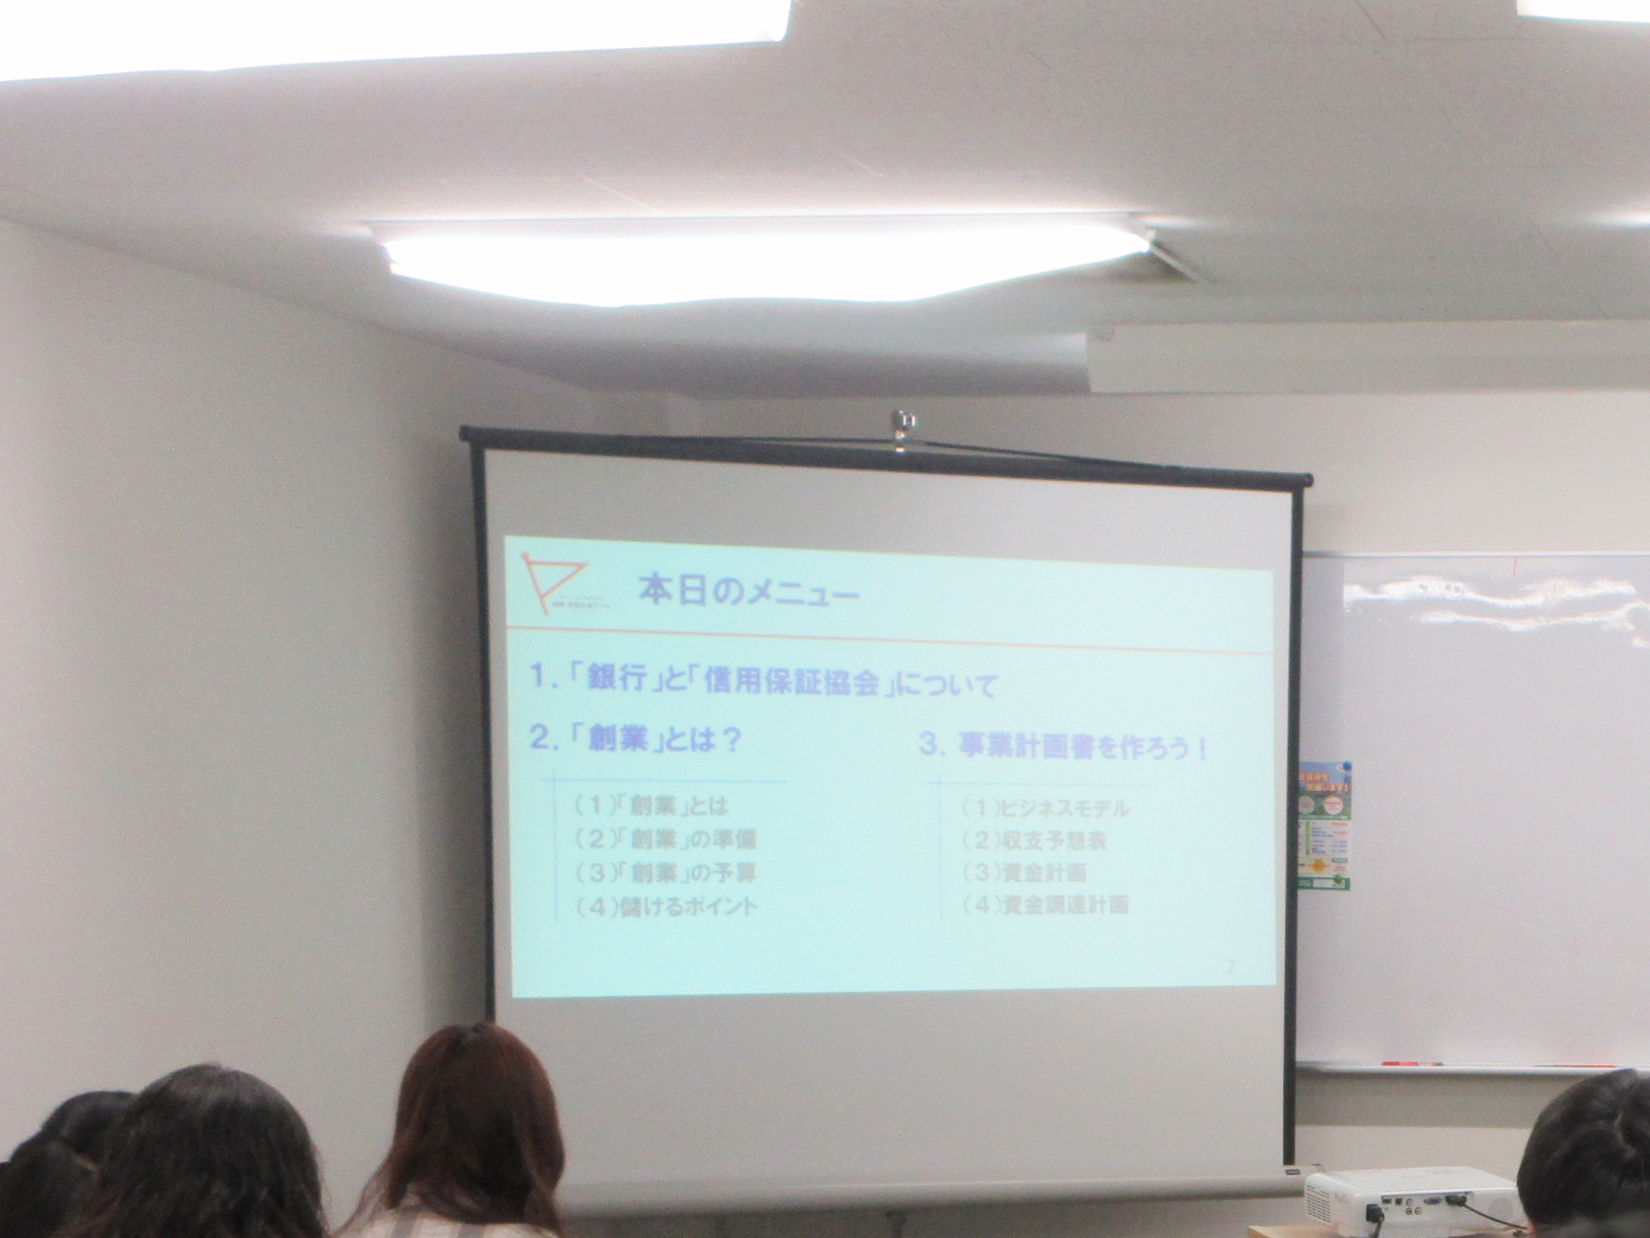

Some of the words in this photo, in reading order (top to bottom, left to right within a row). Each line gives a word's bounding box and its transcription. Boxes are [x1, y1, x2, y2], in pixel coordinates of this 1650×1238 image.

[638, 570, 860, 608] 本日のメニュー
